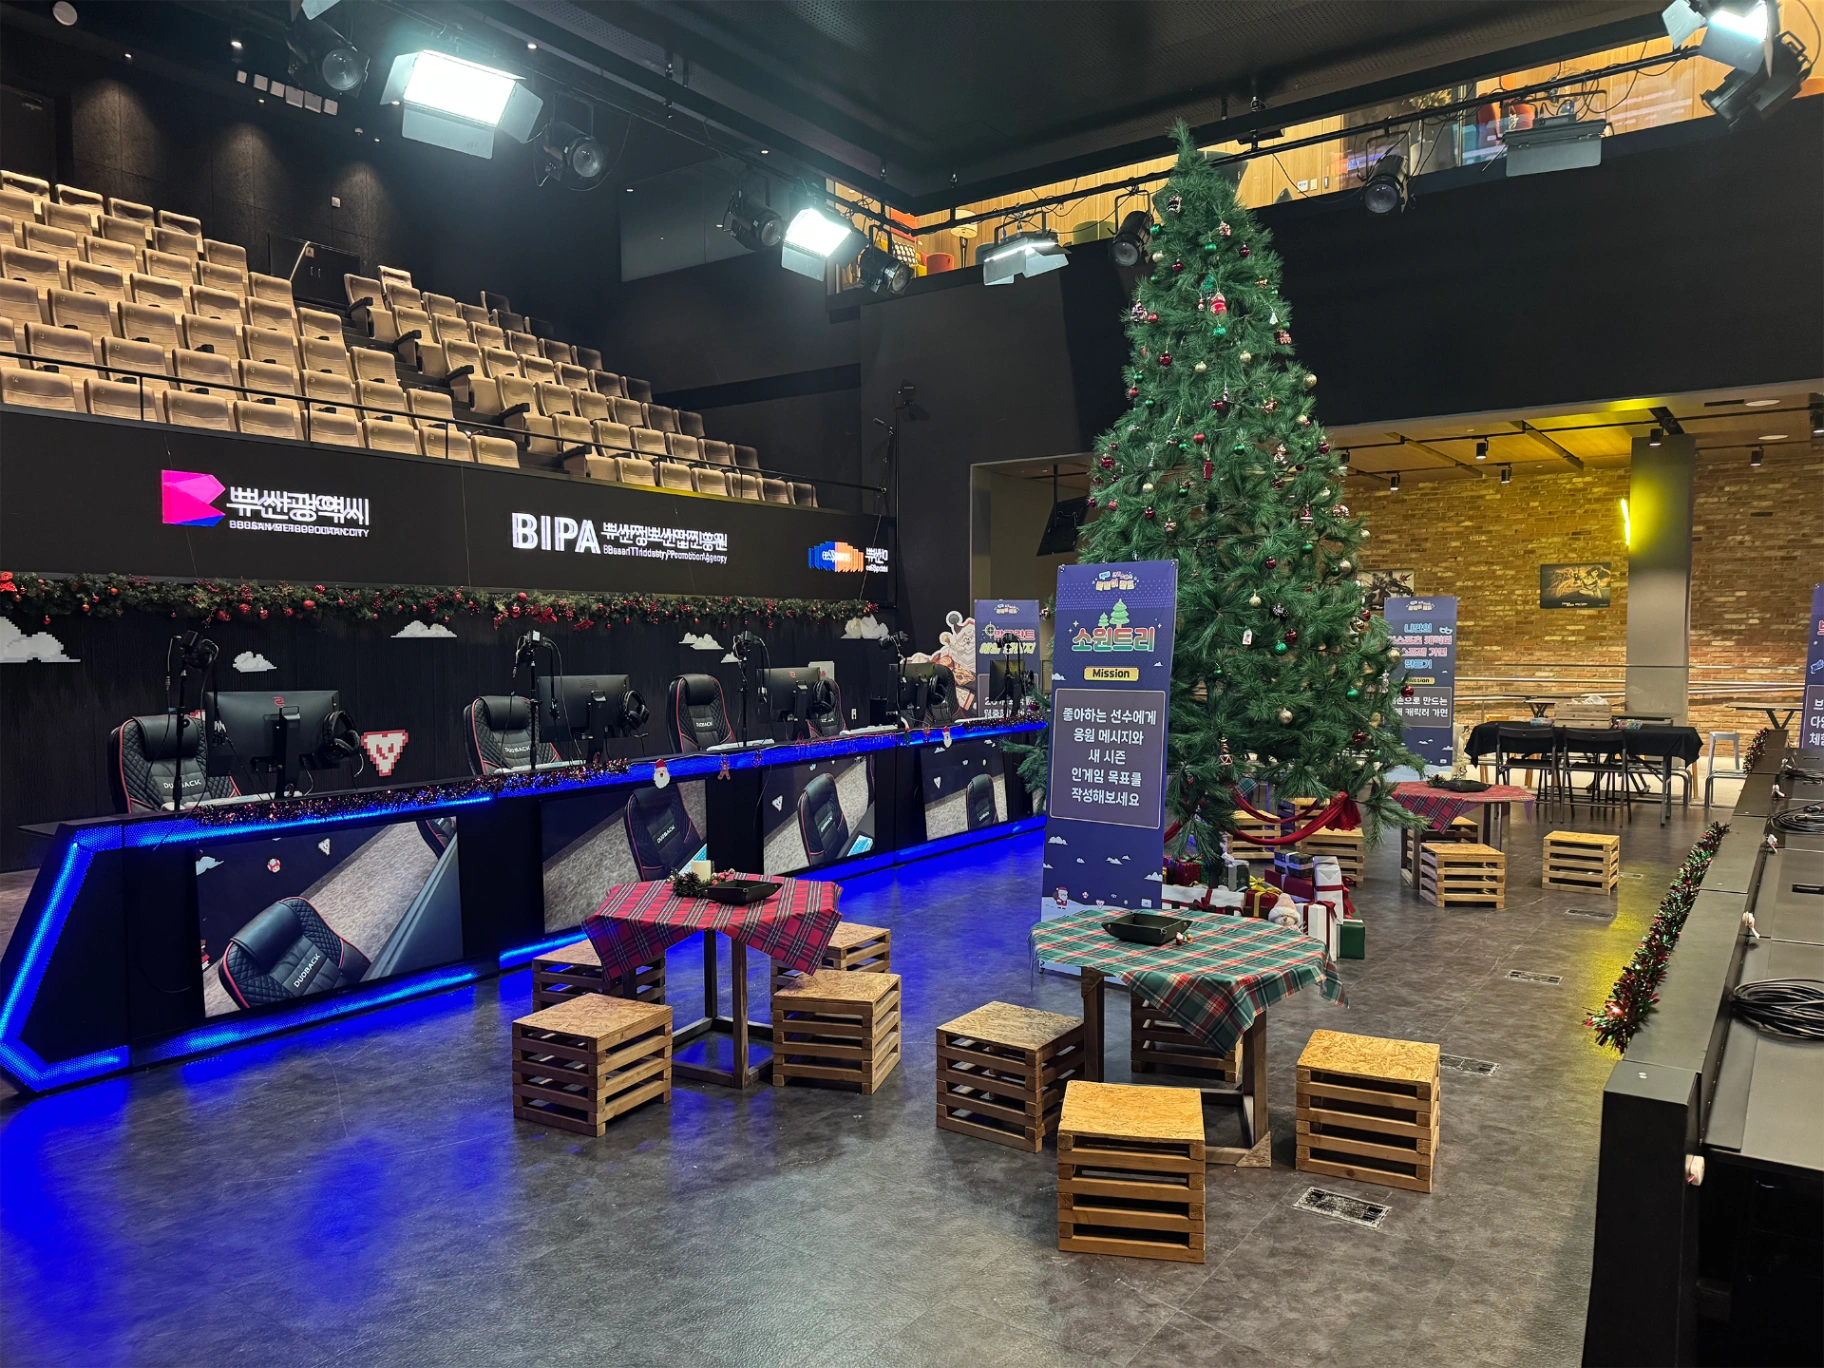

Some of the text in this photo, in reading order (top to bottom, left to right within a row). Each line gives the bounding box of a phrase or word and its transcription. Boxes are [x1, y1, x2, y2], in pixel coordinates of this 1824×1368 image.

[511, 512, 601, 555] BIPA
[1072, 626, 1155, 653] 소원트리
[1092, 668, 1130, 679] Mission
[1422, 696, 1448, 706] 만드는
[1063, 707, 1157, 725] 좋아하는 선수에게
[1405, 708, 1430, 717] 캐릭터
[1432, 708, 1448, 718] 가면
[1073, 727, 1144, 745] 응원 메시지와
[1088, 748, 1126, 765] 새 시즌
[1071, 767, 1142, 787] 인게임 목표를
[1071, 787, 1140, 807] 작성해보세요
[293, 952, 321, 989] DUOBACK
